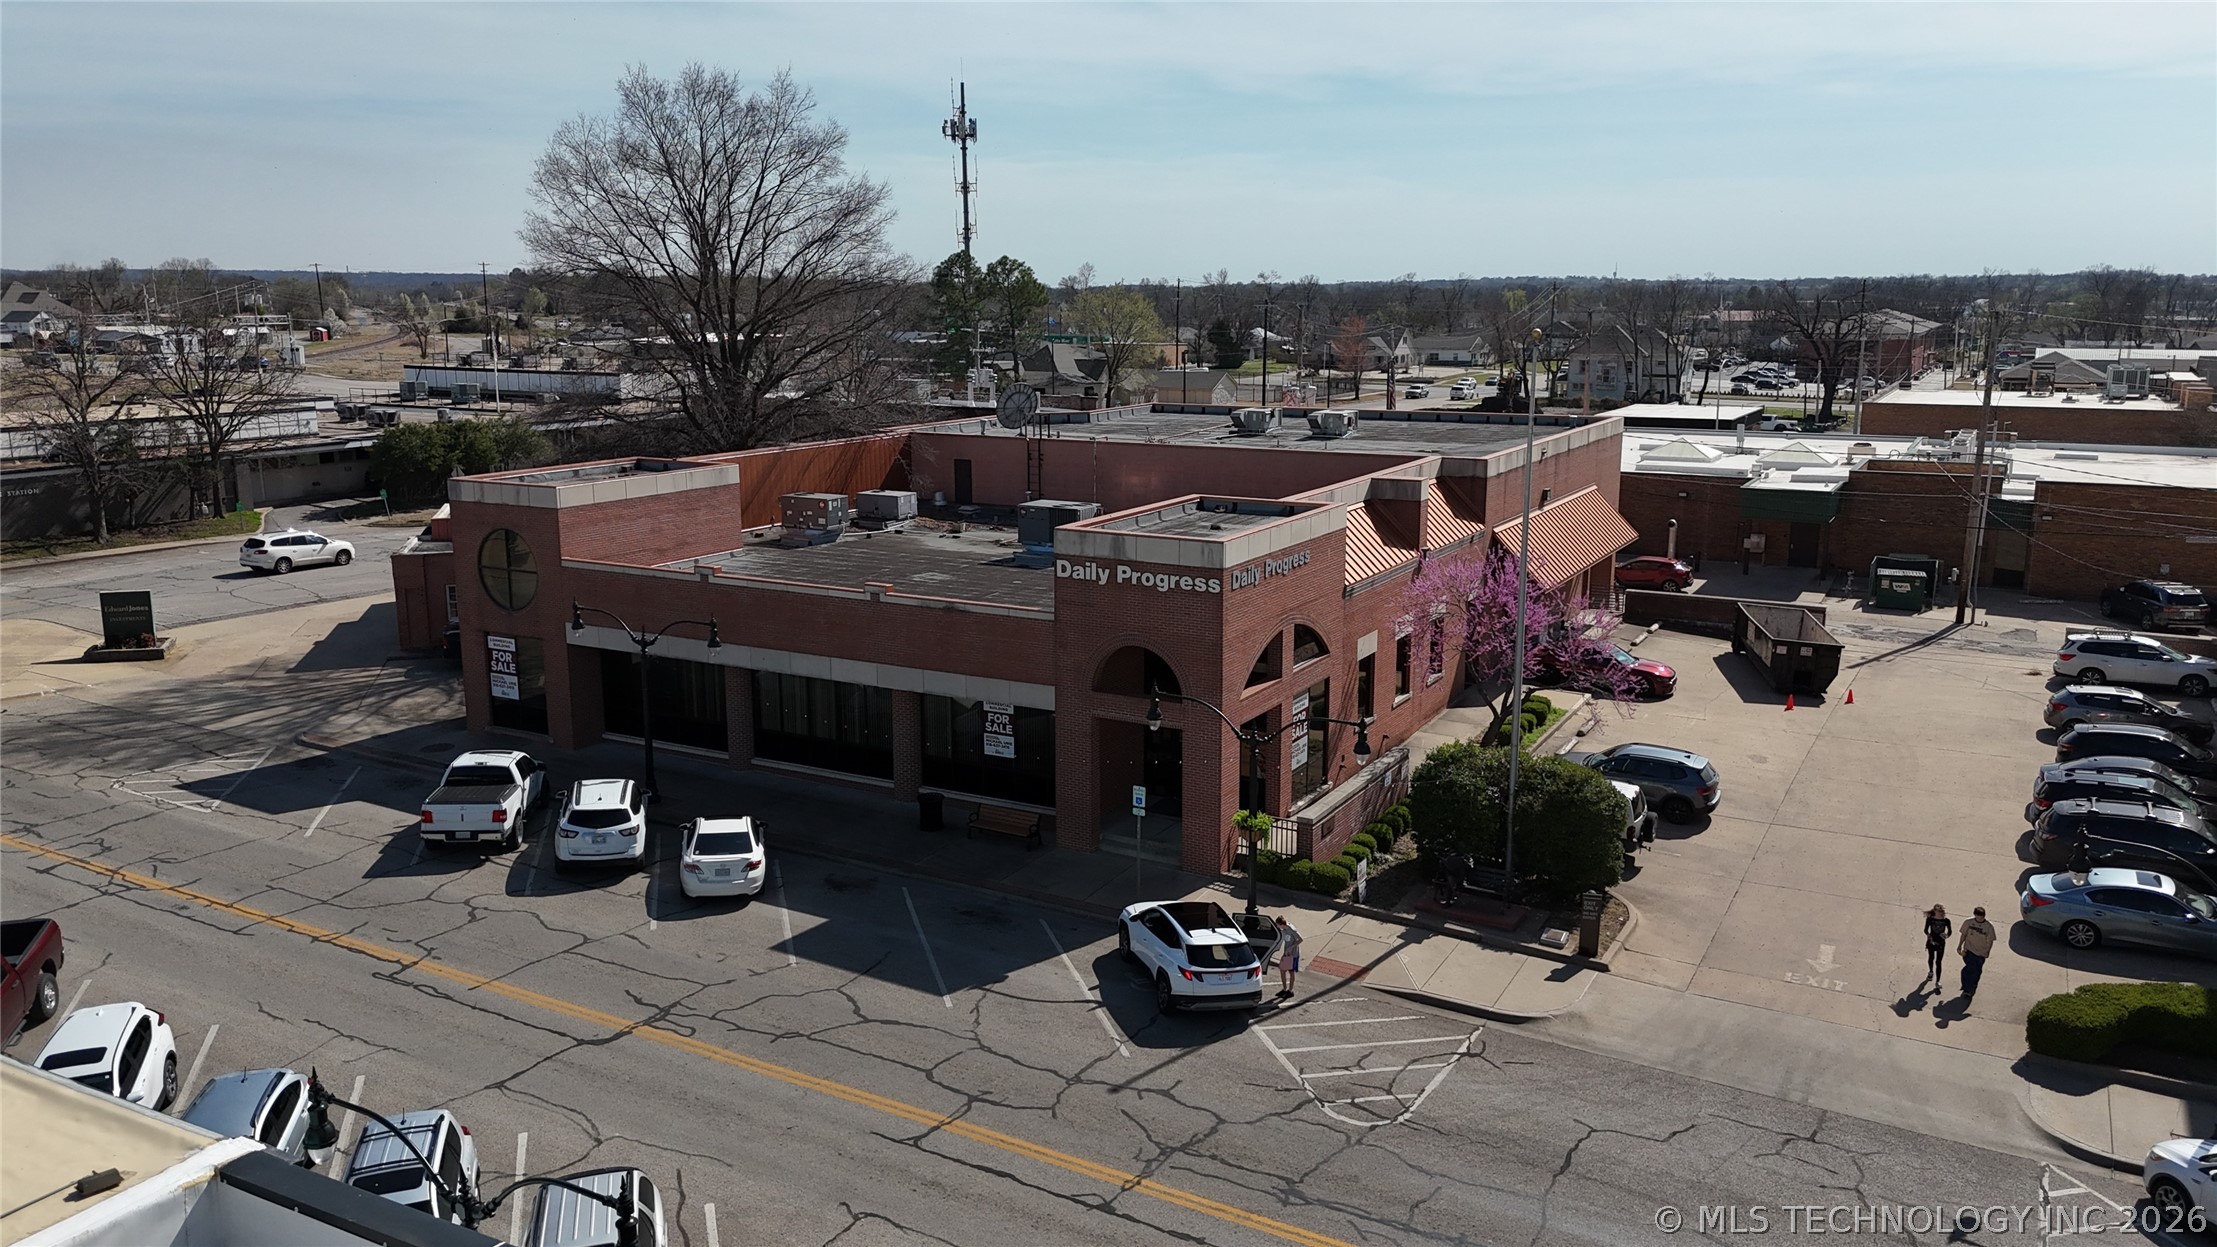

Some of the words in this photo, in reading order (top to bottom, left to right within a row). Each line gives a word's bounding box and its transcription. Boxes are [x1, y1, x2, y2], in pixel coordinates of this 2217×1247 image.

[6, 488, 39, 497] STATION
[1232, 565, 1261, 591] Daily
[1265, 548, 1311, 579] Progress
[1056, 559, 1110, 586] Daily
[1117, 565, 1221, 594] Progress
[489, 637, 514, 646] COMMERCIAL
[492, 650, 513, 663] FOR
[491, 661, 516, 674] SALE
[987, 712, 1010, 725] FOR
[985, 722, 1013, 735] SALE
[1292, 721, 1308, 741] SALE
[1784, 972, 1848, 991] EXIT
